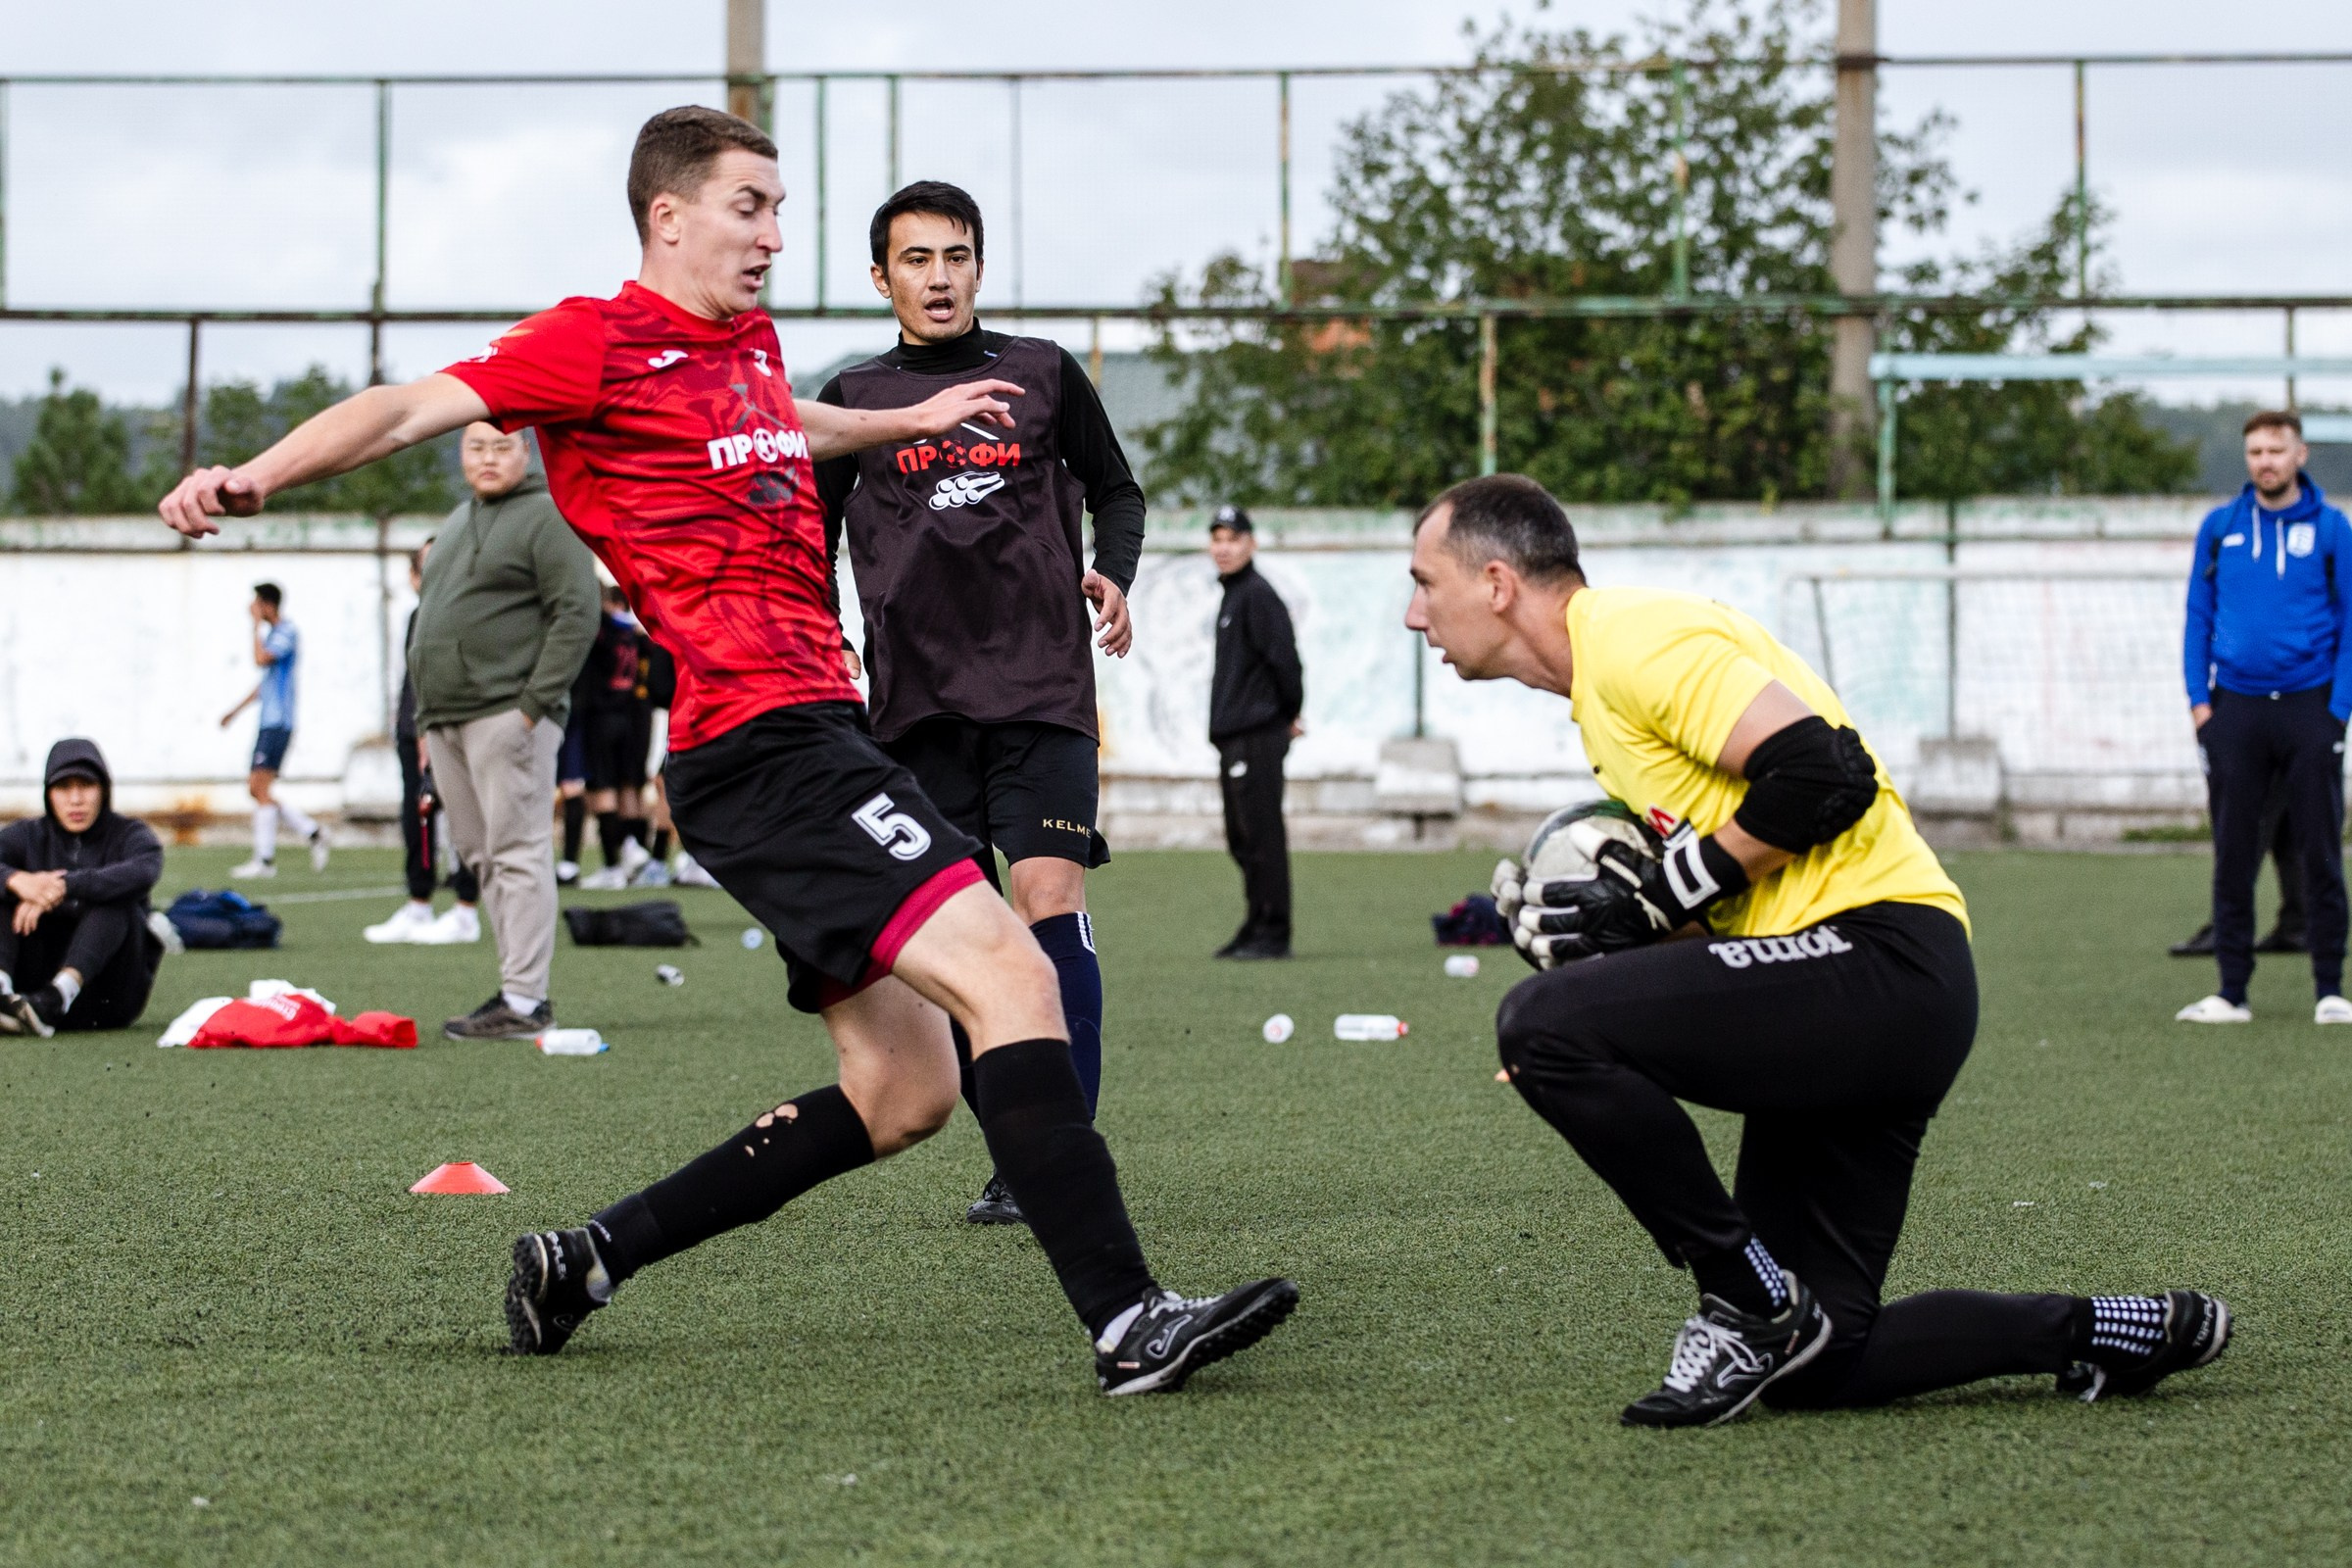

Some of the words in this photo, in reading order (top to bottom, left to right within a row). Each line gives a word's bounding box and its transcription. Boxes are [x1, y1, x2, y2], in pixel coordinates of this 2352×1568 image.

[707, 427, 808, 470] ПРОФИ
[896, 439, 1021, 475] ПРОФИ
[851, 791, 932, 861] 5
[1043, 818, 1092, 839] KELME
